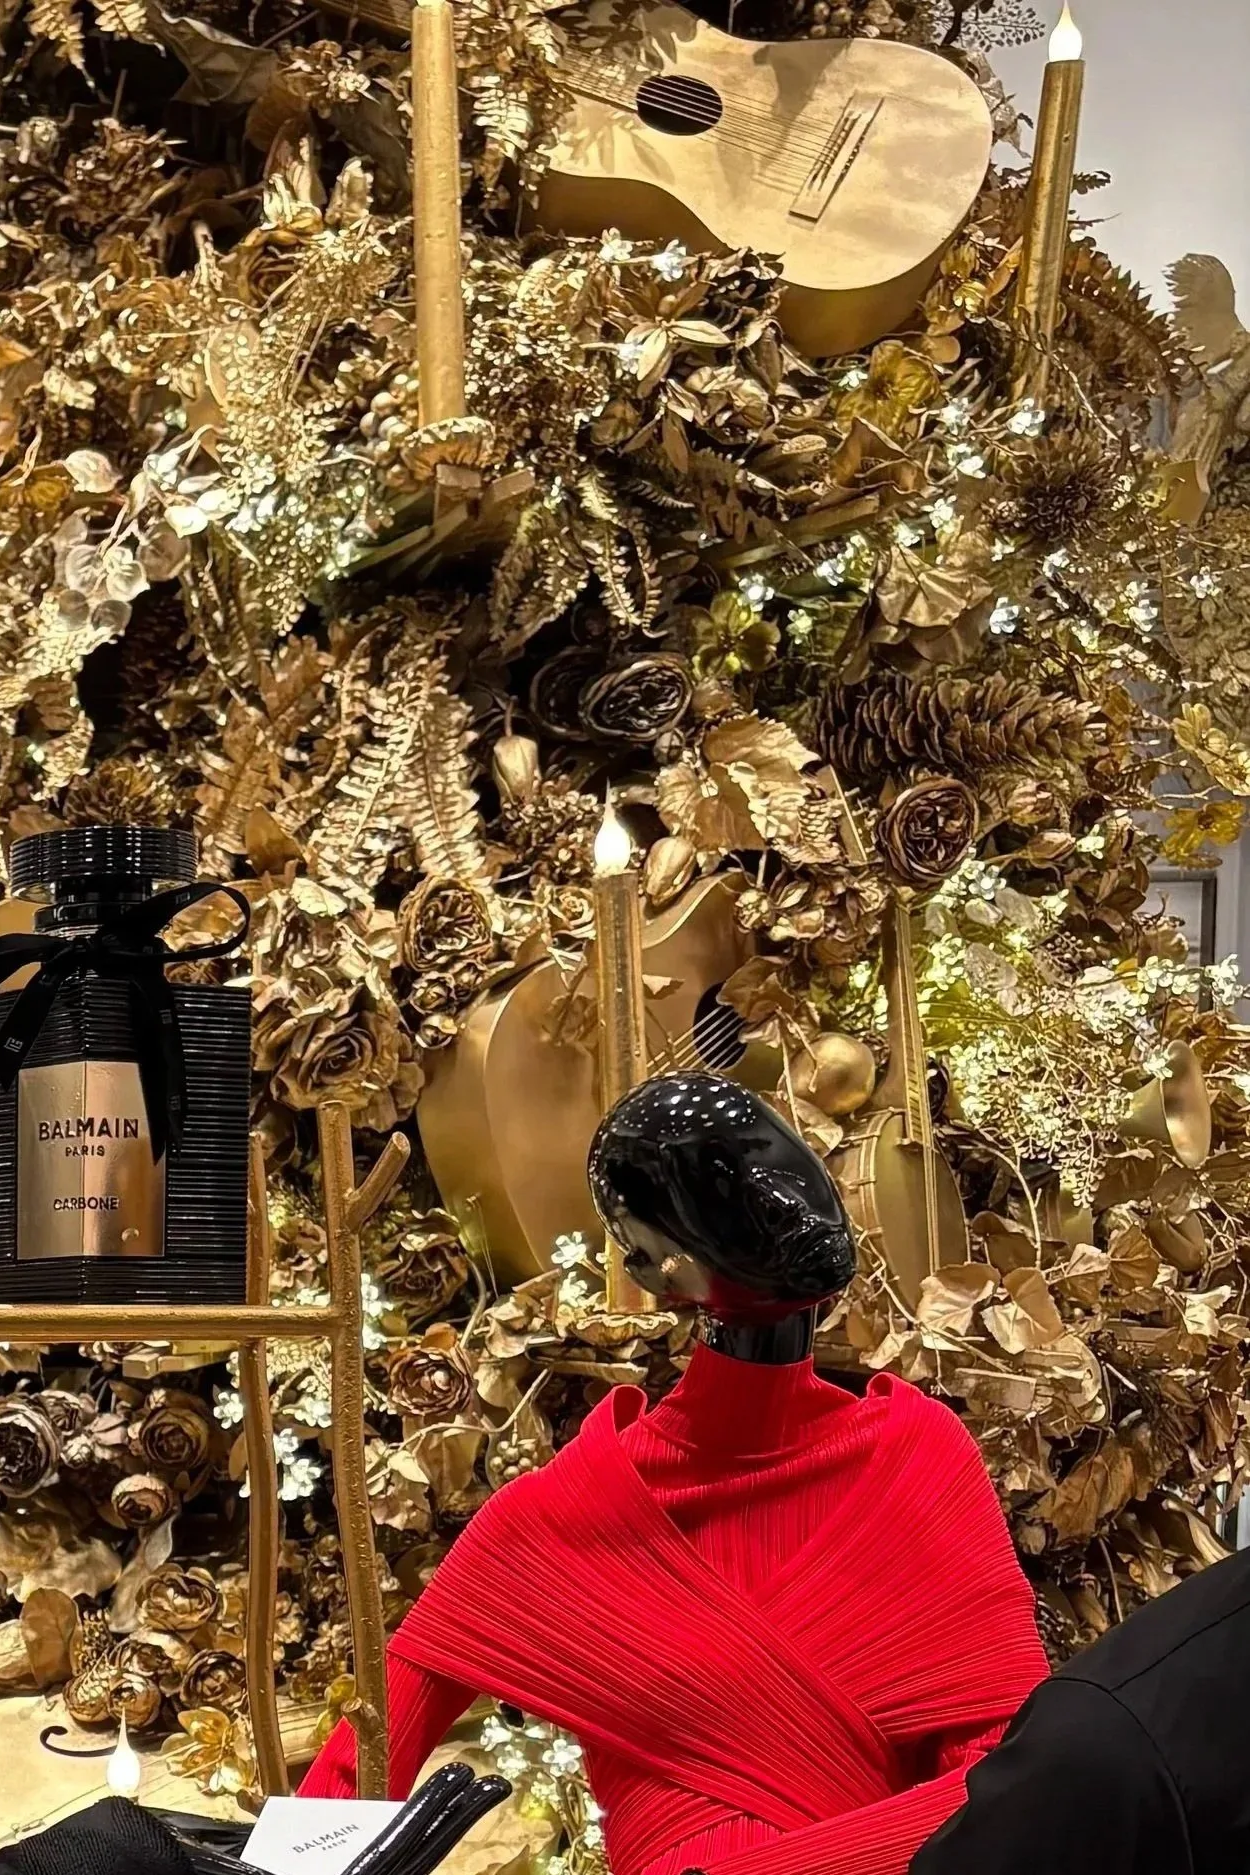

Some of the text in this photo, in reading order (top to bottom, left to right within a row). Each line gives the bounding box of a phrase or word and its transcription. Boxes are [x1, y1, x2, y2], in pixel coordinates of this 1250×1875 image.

[38, 1117, 139, 1141] BALMAIN
[65, 1145, 105, 1157] PARIS
[53, 1197, 119, 1211] CARBONE
[292, 1823, 359, 1854] BALMAIN
